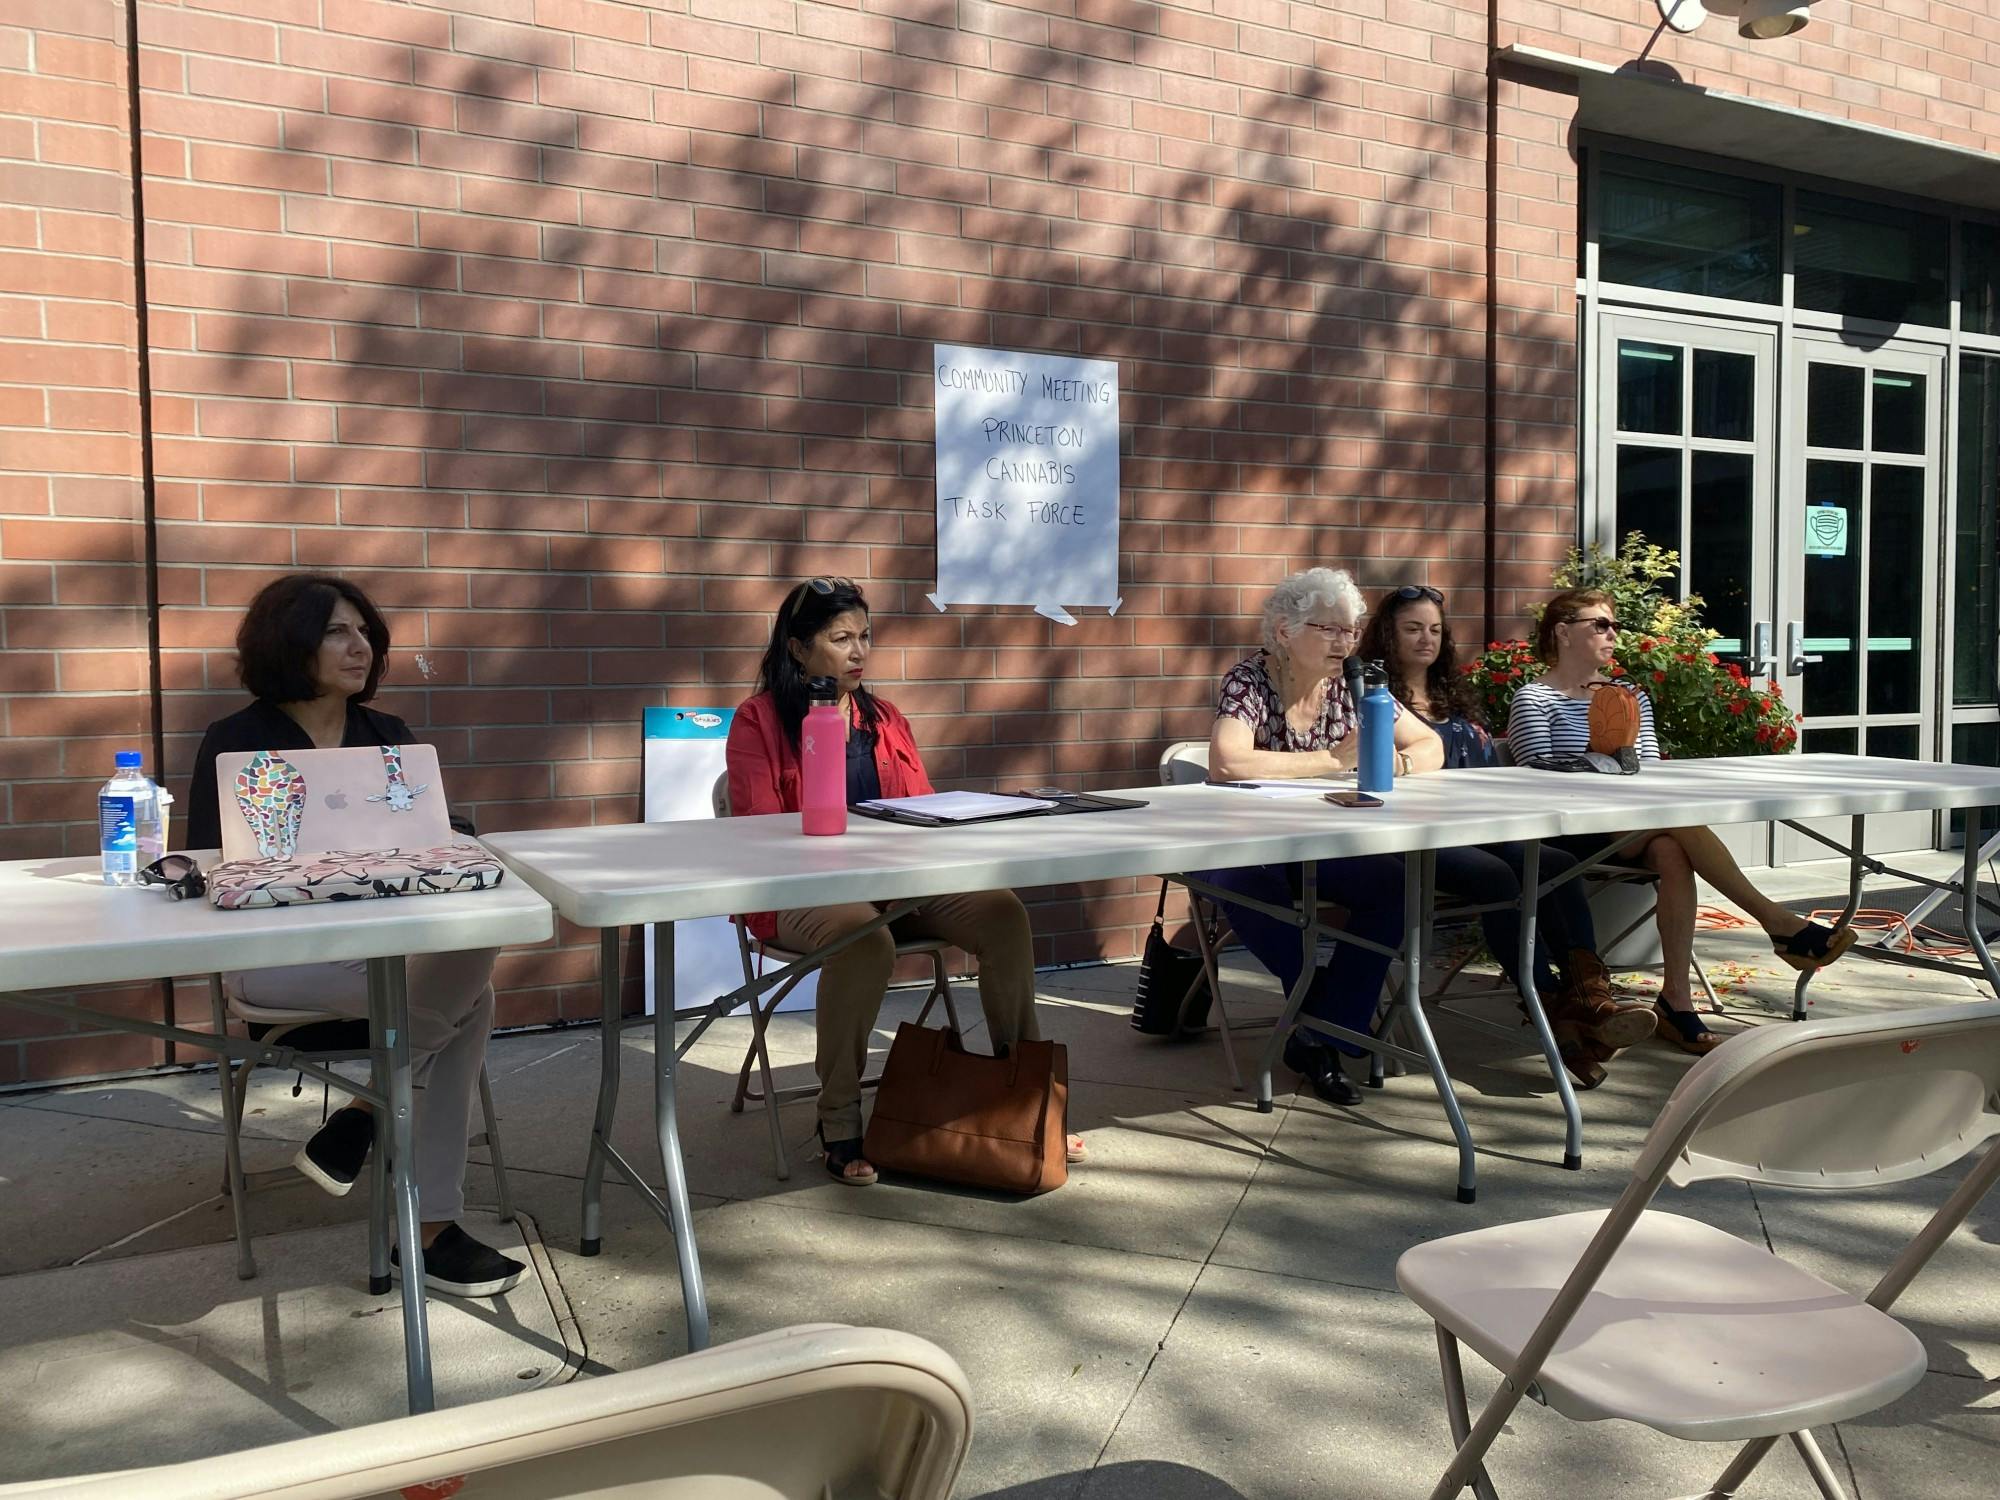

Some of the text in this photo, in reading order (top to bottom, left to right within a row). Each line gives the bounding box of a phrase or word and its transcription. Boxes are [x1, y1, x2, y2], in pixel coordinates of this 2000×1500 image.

[938, 365, 1109, 403] COMMUNITY MEETING
[982, 417, 1083, 447] PRINCETON
[986, 457, 1075, 484] CANNABIS
[944, 497, 1085, 525] TASK FORCE
